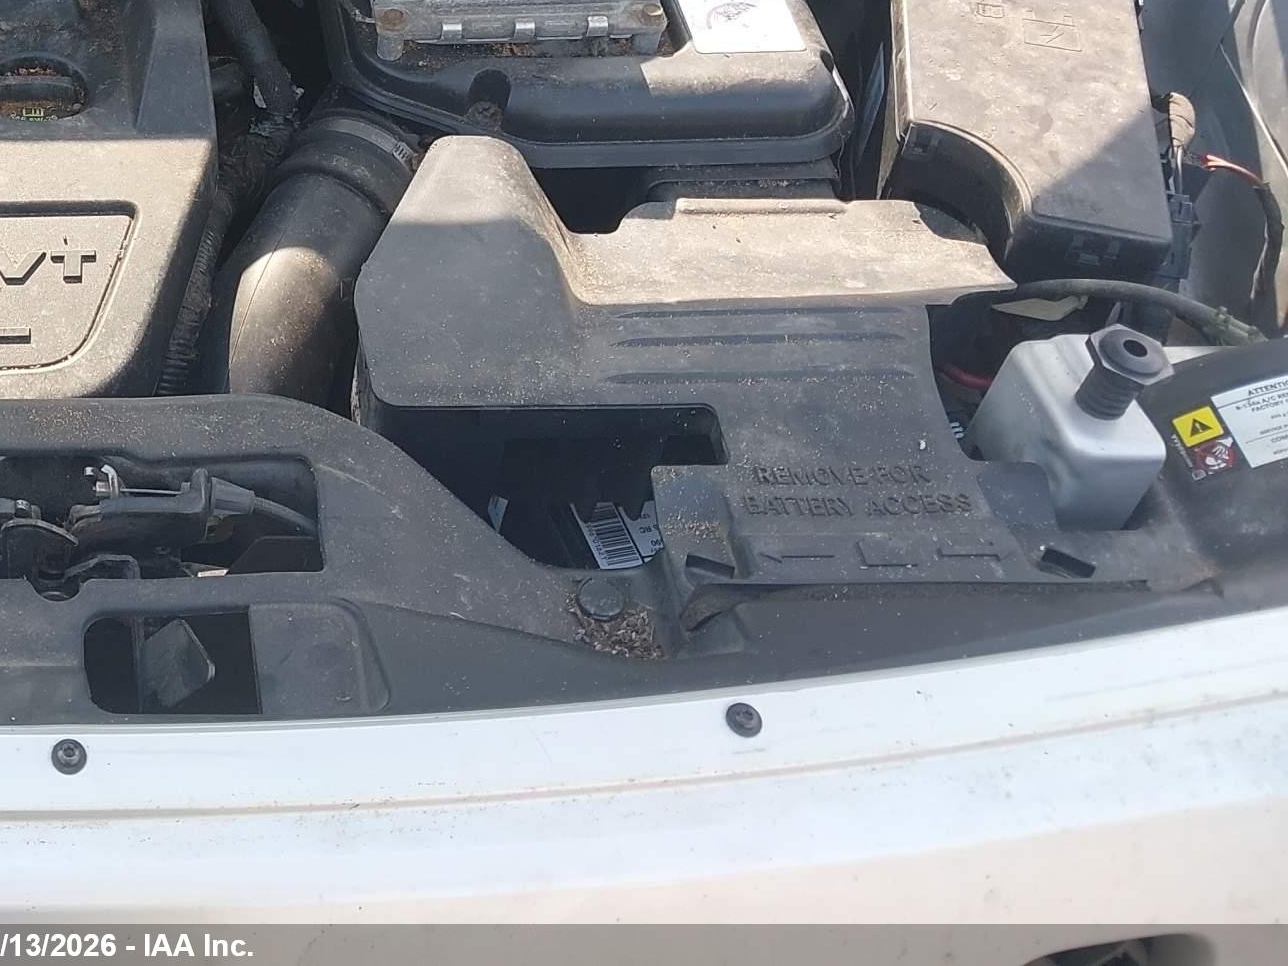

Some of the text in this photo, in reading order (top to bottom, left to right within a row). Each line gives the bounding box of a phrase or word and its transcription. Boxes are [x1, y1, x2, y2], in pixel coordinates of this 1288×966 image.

[754, 464, 933, 487] REMOVE FOR
[742, 492, 975, 517] BATTERY ACCESS
